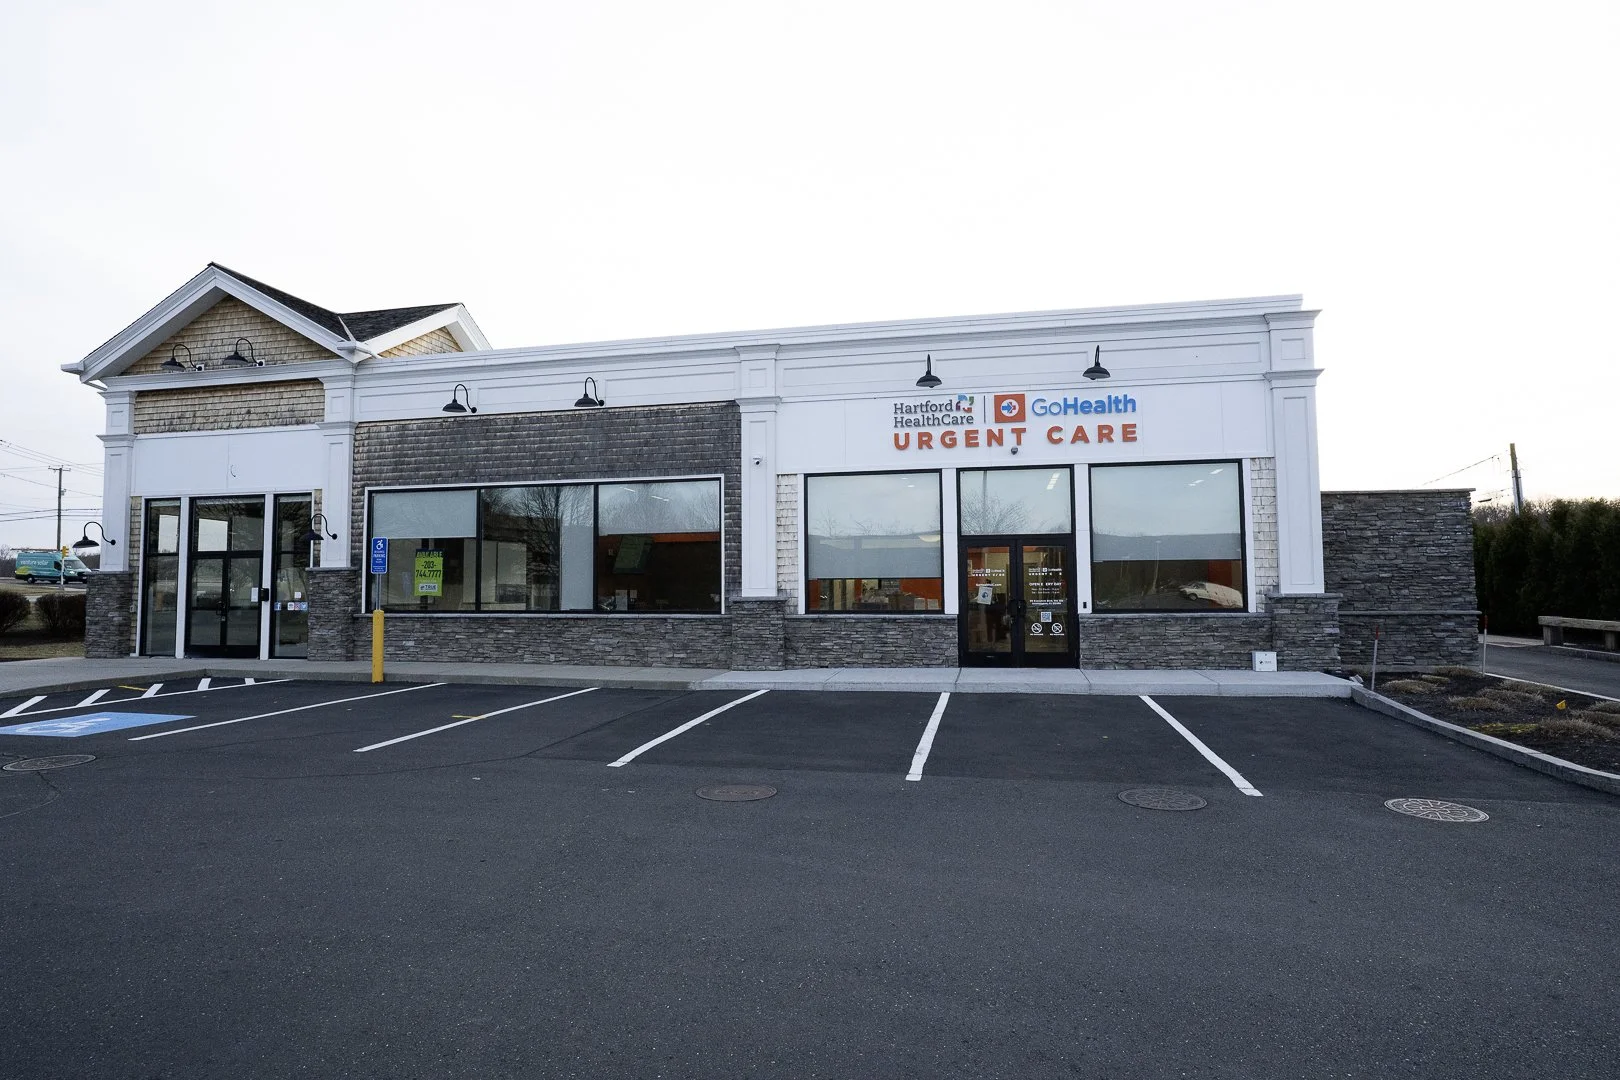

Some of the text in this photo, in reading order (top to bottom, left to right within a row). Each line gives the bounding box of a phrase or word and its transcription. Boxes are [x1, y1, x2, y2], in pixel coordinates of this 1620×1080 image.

[894, 400, 953, 414] Hartford
[1032, 394, 1137, 416] GoHealth
[894, 414, 974, 428] HealthCare
[894, 423, 1137, 450] URGENT CARE
